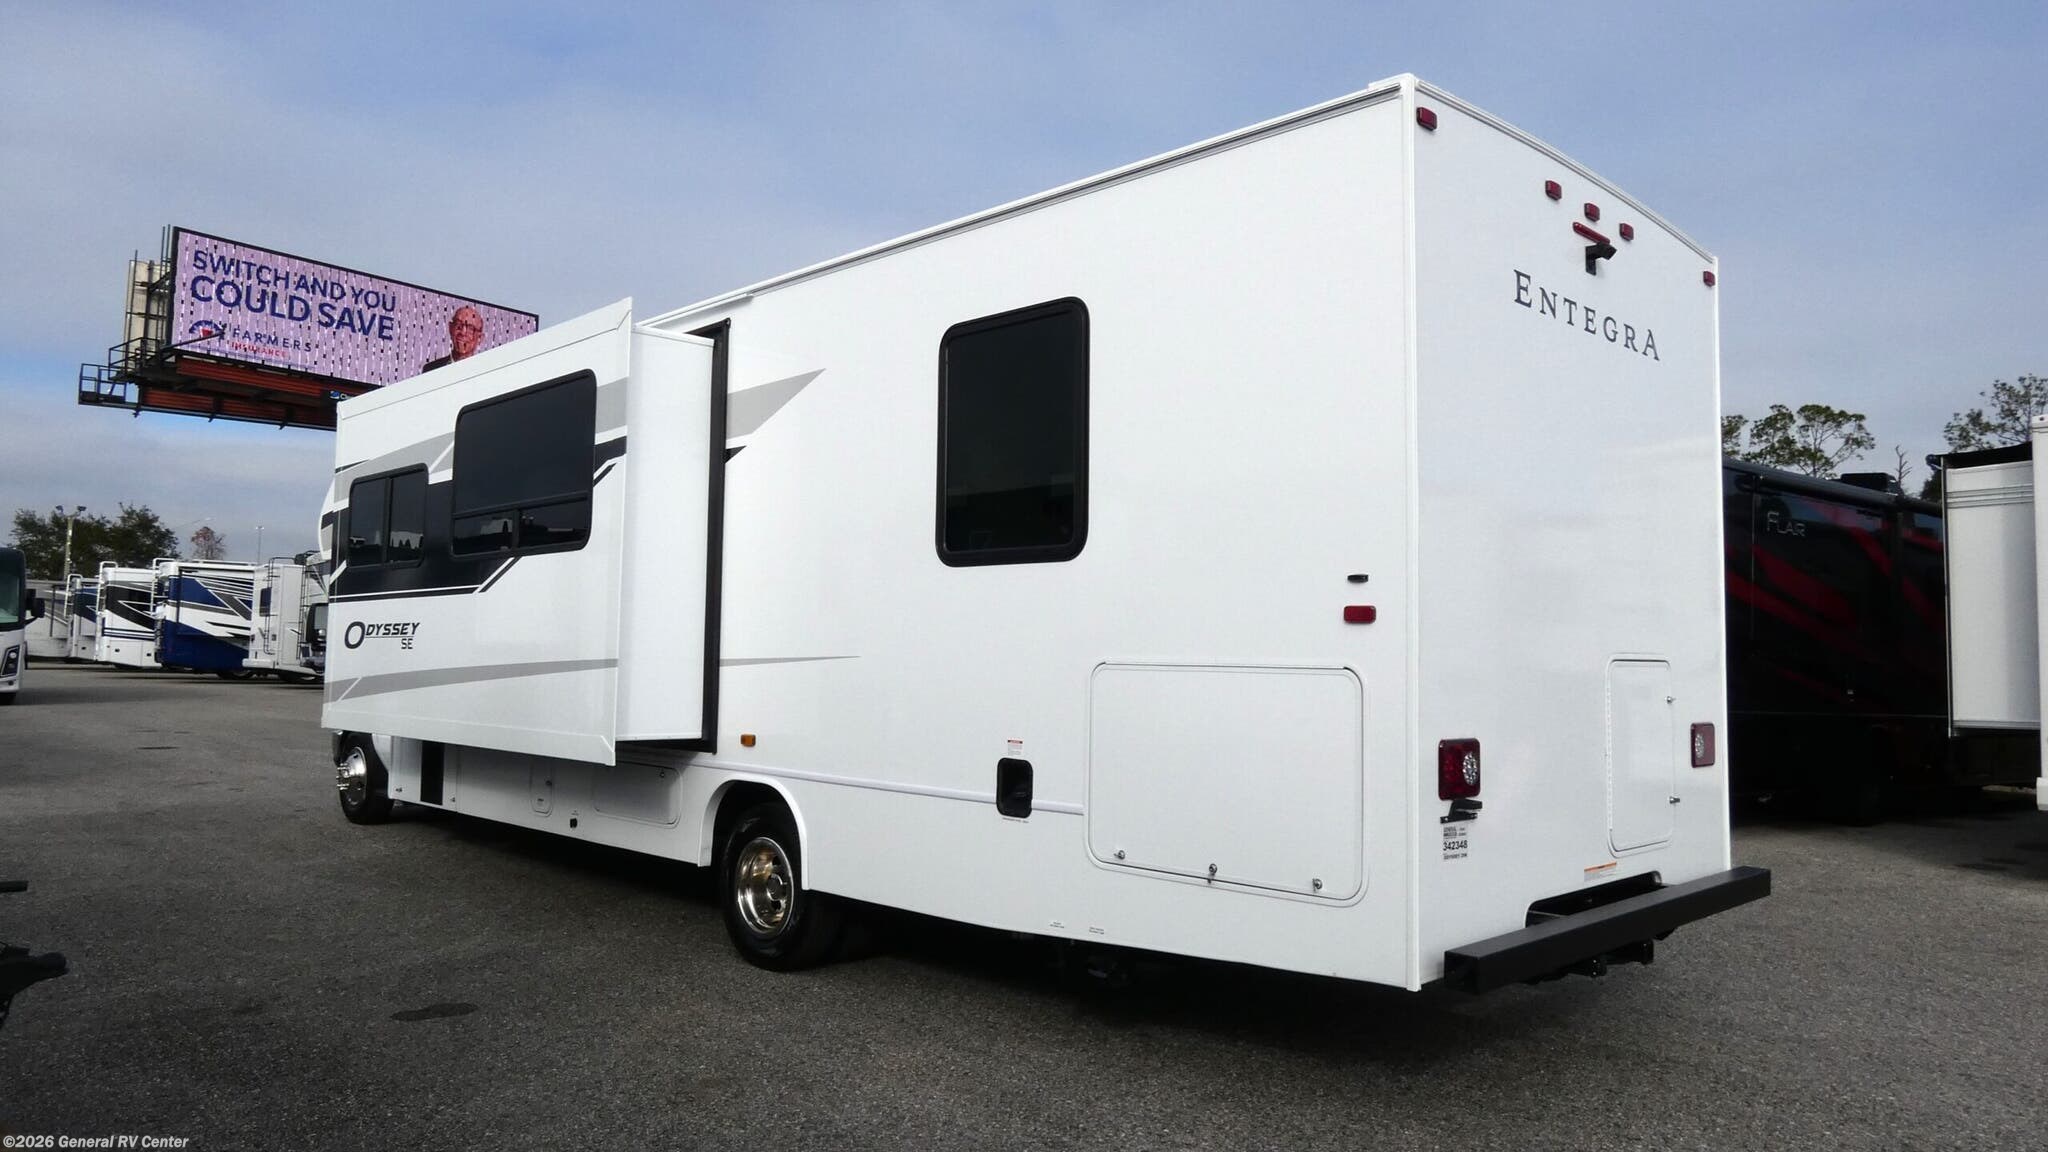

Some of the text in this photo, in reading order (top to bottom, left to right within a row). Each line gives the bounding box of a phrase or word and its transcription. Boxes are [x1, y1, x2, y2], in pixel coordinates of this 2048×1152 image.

[193, 250, 396, 312] SWITCH AND YOU
[191, 275, 395, 341] COULD SAVE
[1513, 269, 1660, 361] ENTEGRA
[232, 328, 312, 352] FARMERS
[344, 621, 421, 649] ODYSSEY
[401, 638, 413, 649] SE
[1443, 840, 1468, 851] 342348
